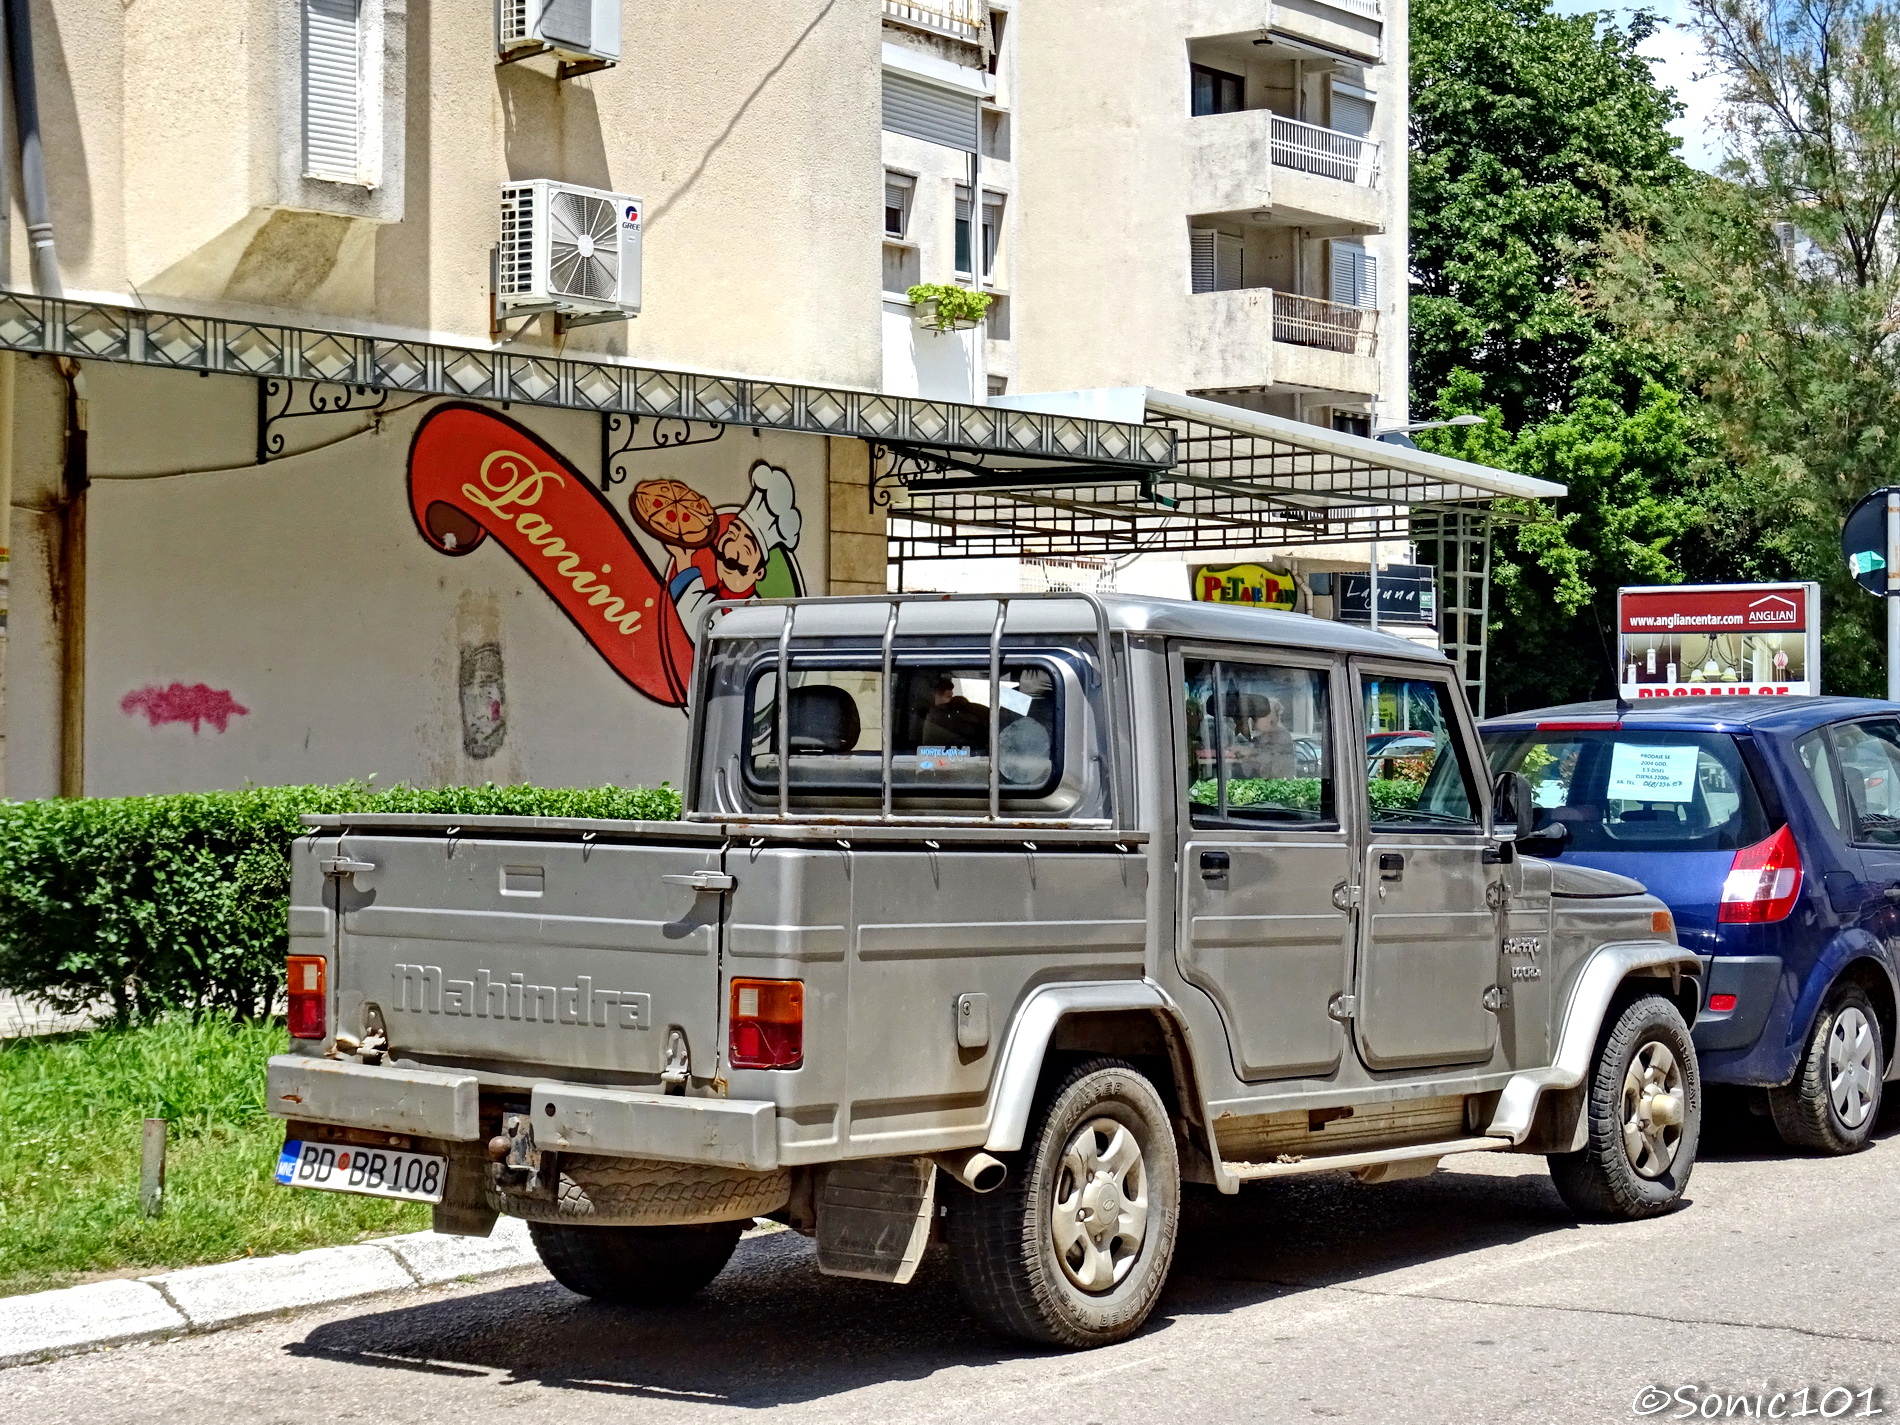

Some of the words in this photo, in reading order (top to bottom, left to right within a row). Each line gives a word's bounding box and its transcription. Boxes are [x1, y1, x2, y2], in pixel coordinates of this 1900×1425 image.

[622, 222, 641, 231] GREE
[461, 450, 655, 635] Panini
[1629, 613, 1744, 629] www.angliancentar.com
[1749, 610, 1794, 621] ANGLIAN
[392, 963, 652, 1030] Mahindra
[277, 1161, 296, 1178] MNE
[298, 1145, 336, 1183] BD
[347, 1150, 441, 1196] BB108
